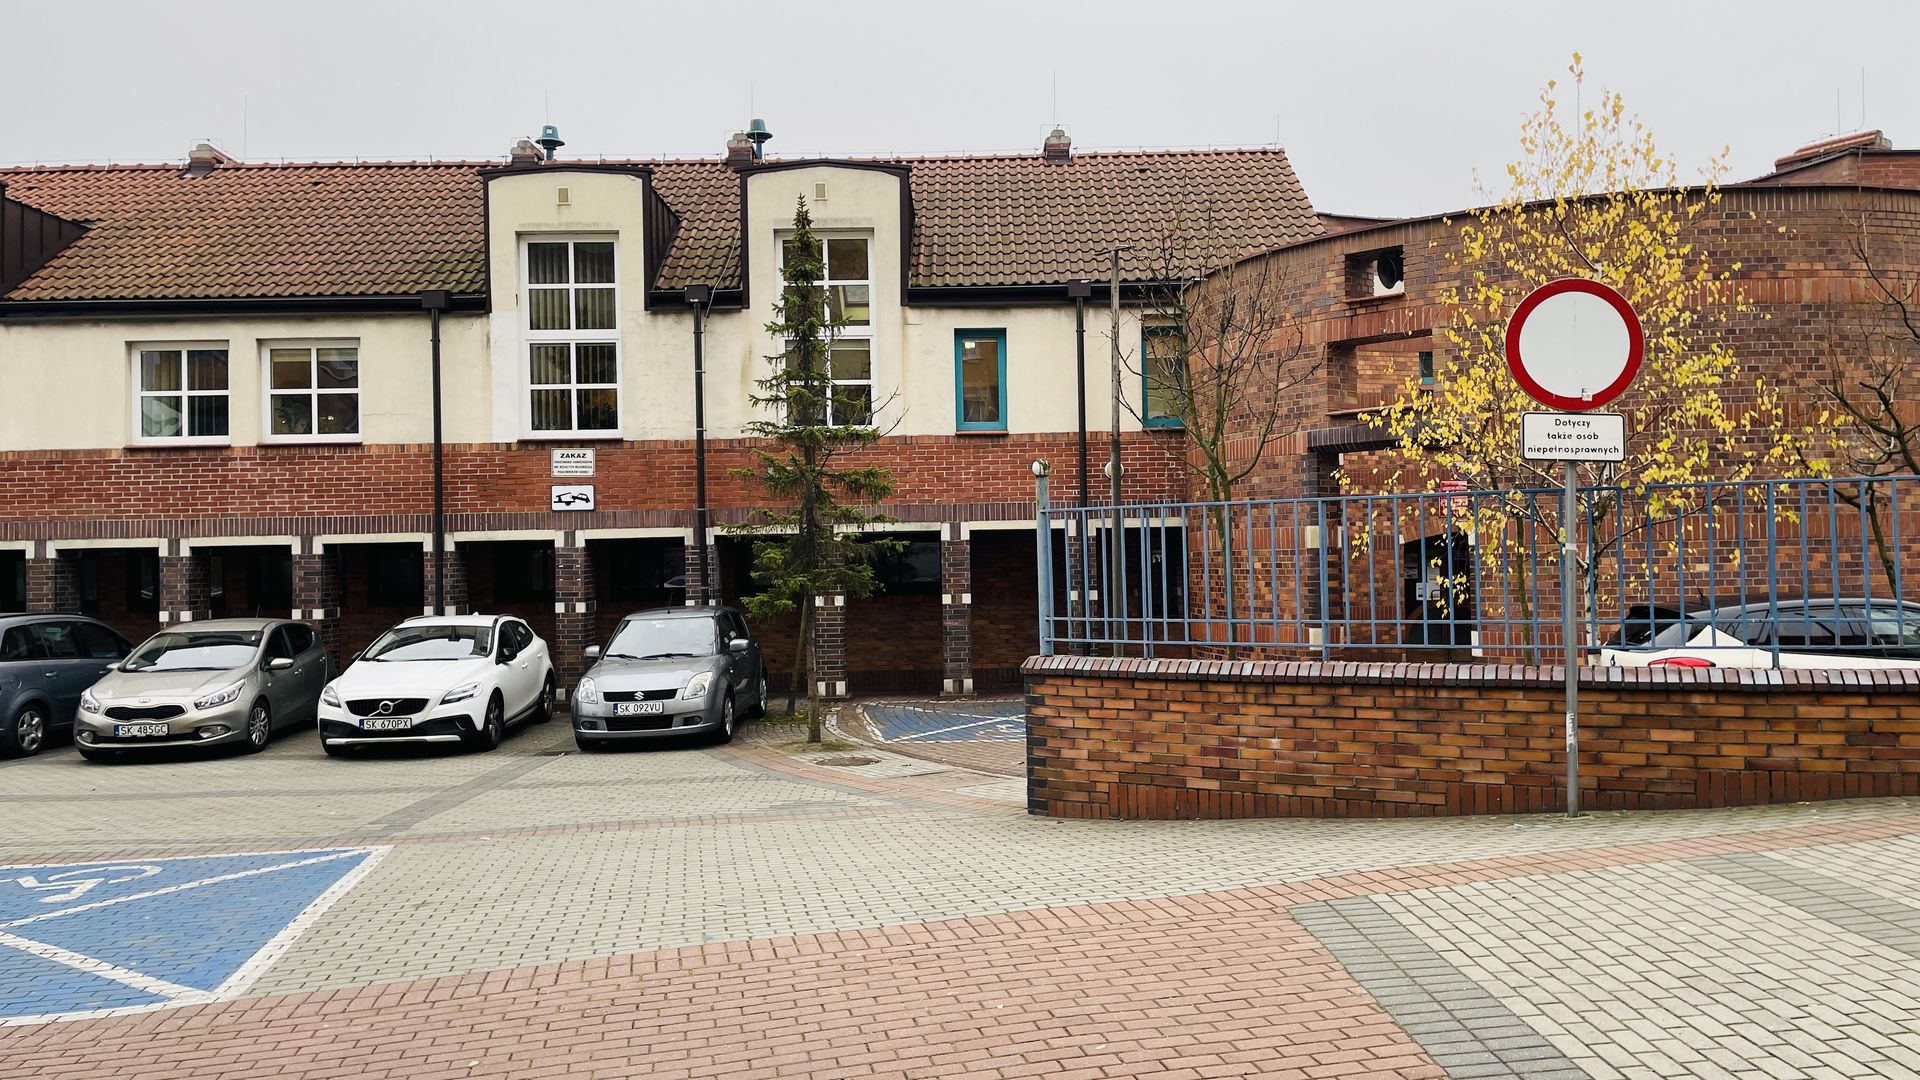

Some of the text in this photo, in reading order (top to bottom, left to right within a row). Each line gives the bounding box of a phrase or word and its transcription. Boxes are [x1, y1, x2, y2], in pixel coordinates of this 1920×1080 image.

[1554, 418, 1591, 428] Dotyczy
[1547, 431, 1573, 440] także
[1527, 445, 1619, 455] niepełnosprawnych
[620, 703, 661, 713] SK 092VU
[365, 719, 409, 729] SK 670PX
[120, 725, 167, 735] SK 485GC
